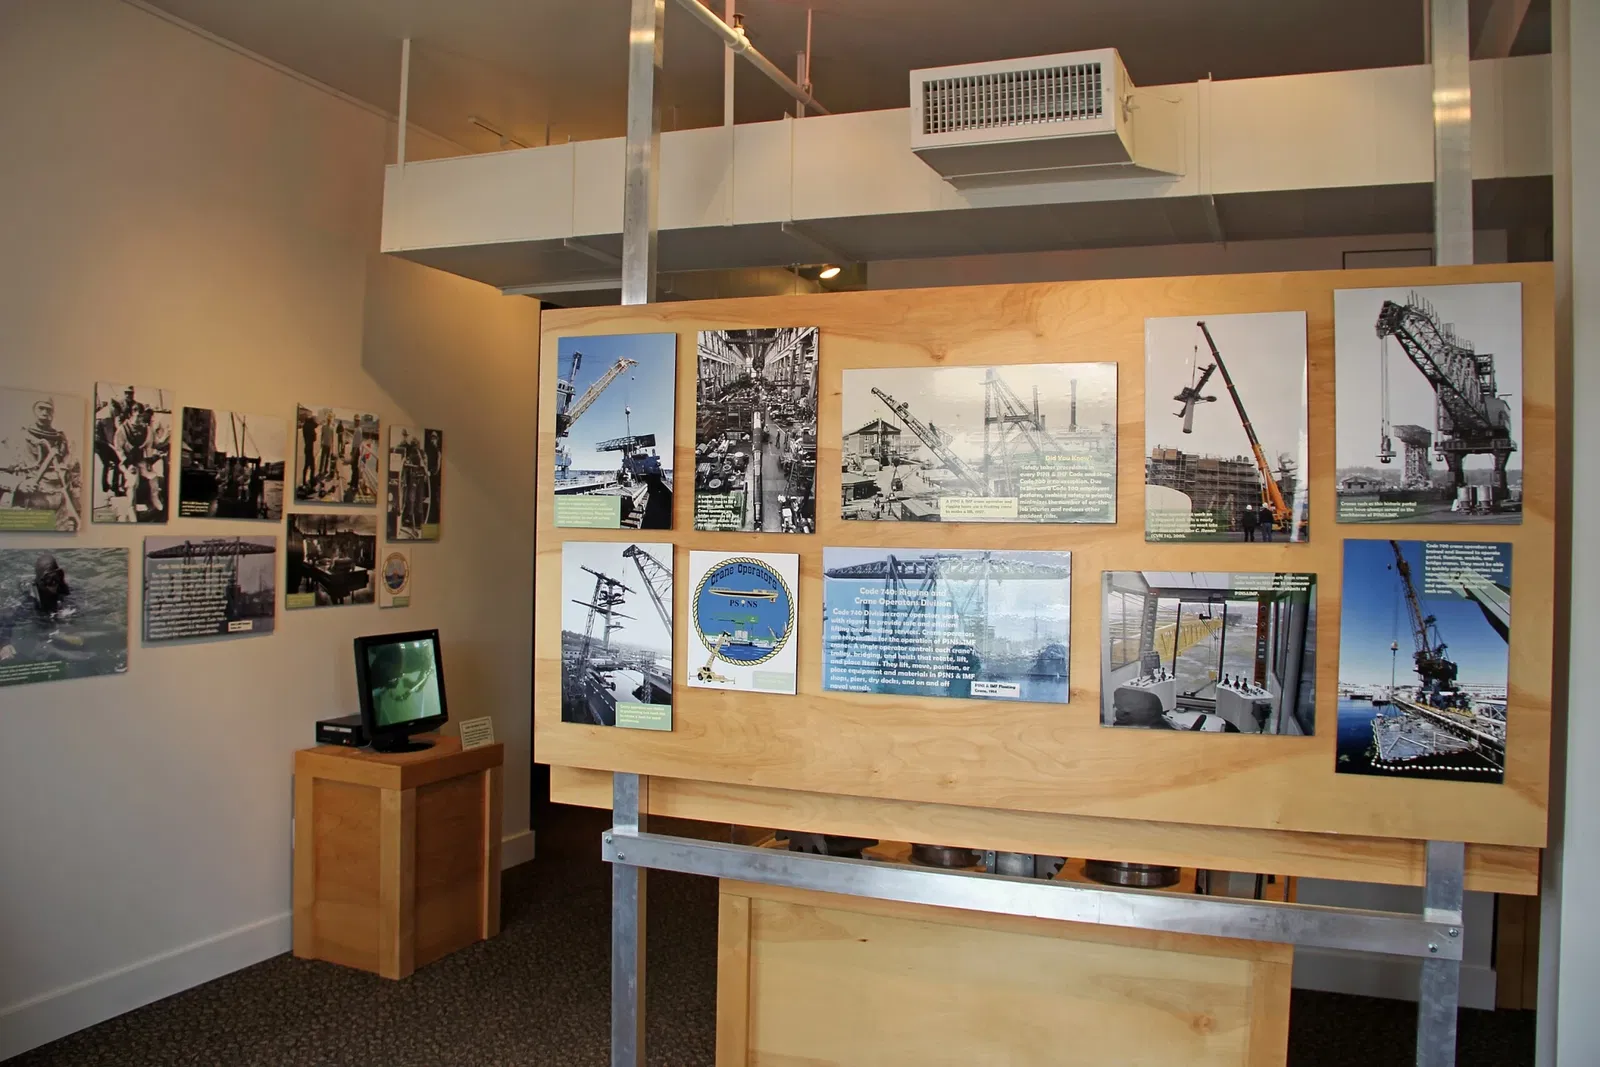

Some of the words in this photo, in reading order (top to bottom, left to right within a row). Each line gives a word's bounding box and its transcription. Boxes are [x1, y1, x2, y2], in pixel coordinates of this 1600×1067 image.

[710, 566, 734, 586] Crane
[737, 563, 777, 590] Operators
[900, 589, 929, 598] Rigging
[855, 597, 877, 605] Crane
[921, 599, 951, 607] Division
[910, 611, 940, 620] operators
[847, 618, 867, 626] riggers
[877, 619, 901, 627] provide
[865, 626, 893, 635] handling
[943, 629, 974, 638] operators
[901, 636, 932, 645] operation
[880, 644, 907, 653] operator
[831, 650, 852, 658] trolley,
[854, 651, 882, 660] bridging,
[933, 654, 955, 662] rotate,
[933, 662, 961, 672] position,
[848, 667, 883, 677] equipment
[898, 669, 928, 677] materials
[849, 683, 871, 691] vessels.
